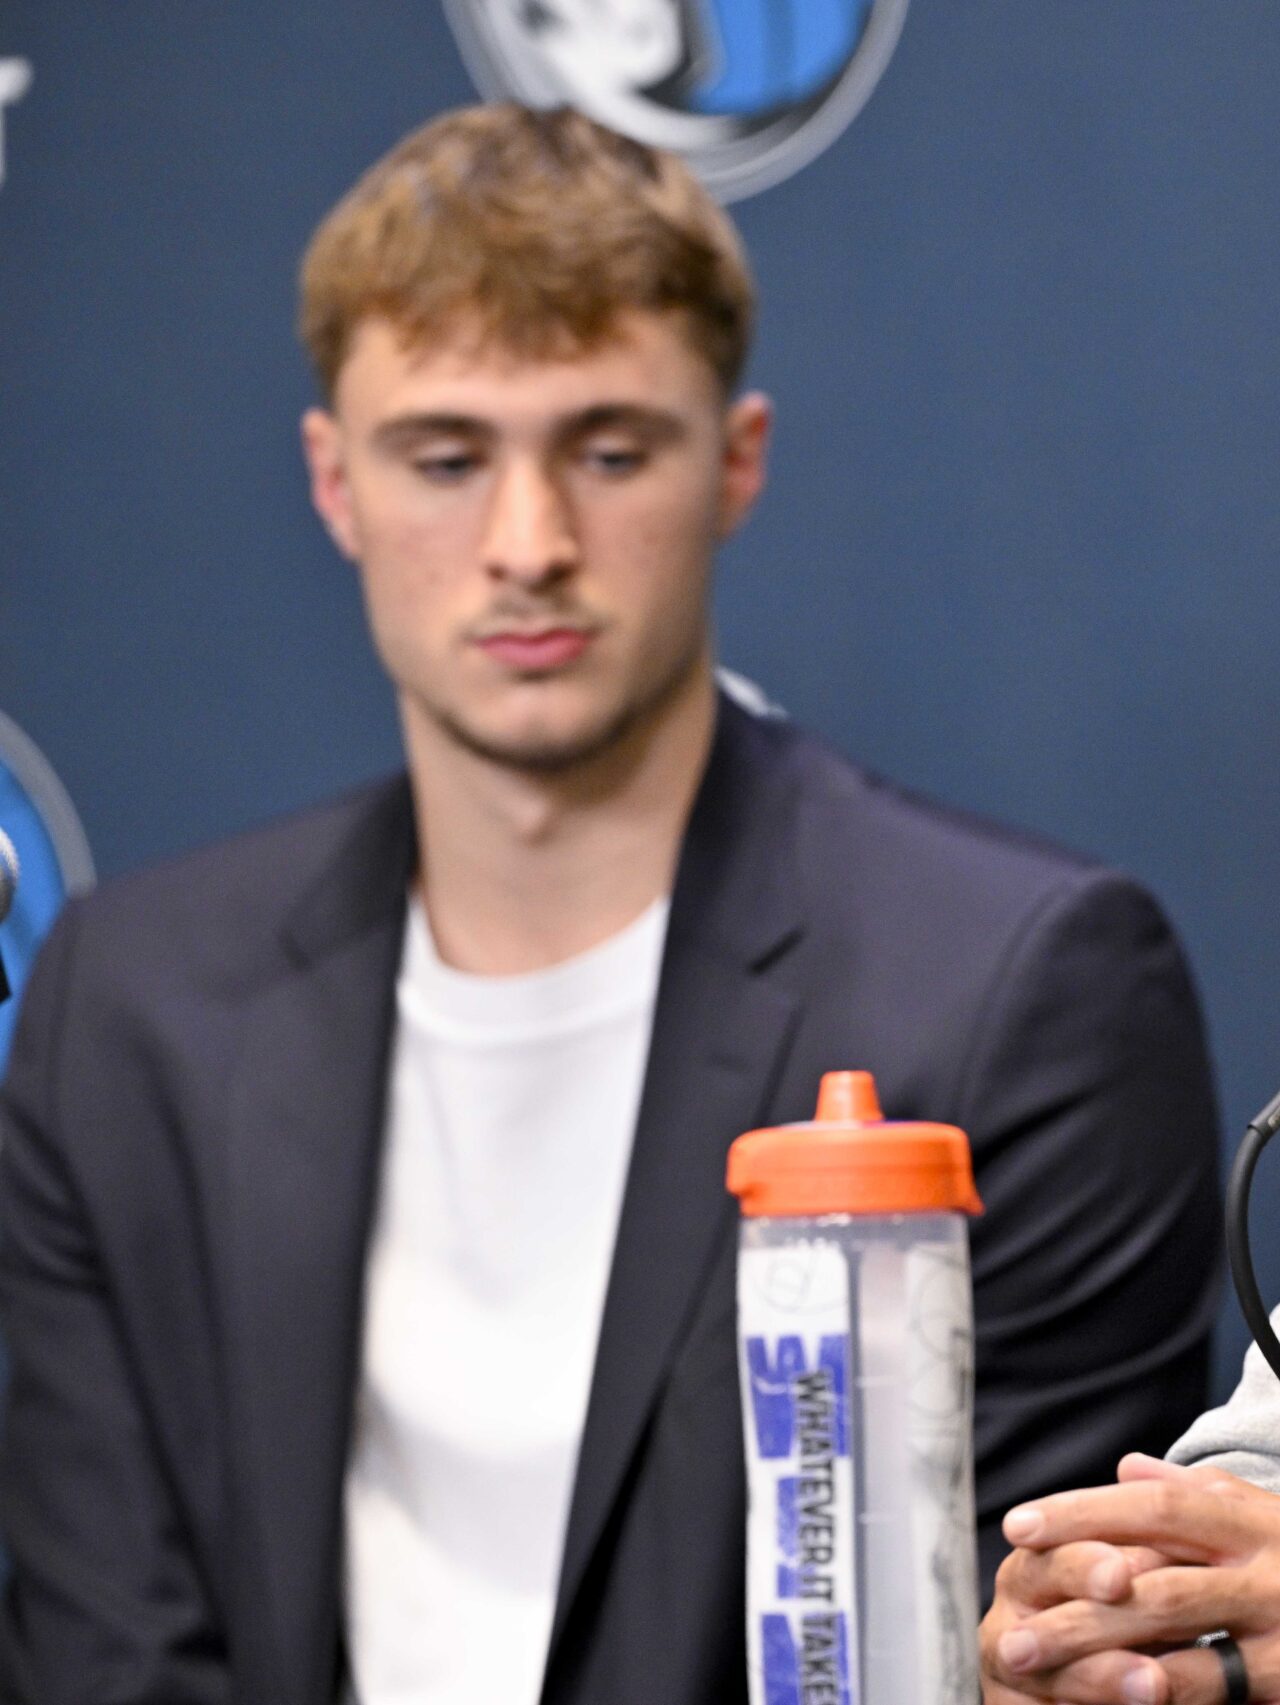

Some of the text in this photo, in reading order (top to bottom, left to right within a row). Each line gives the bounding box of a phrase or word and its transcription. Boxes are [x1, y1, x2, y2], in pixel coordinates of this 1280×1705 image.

[797, 1370, 836, 1705] WHATEVER IT TAKE
